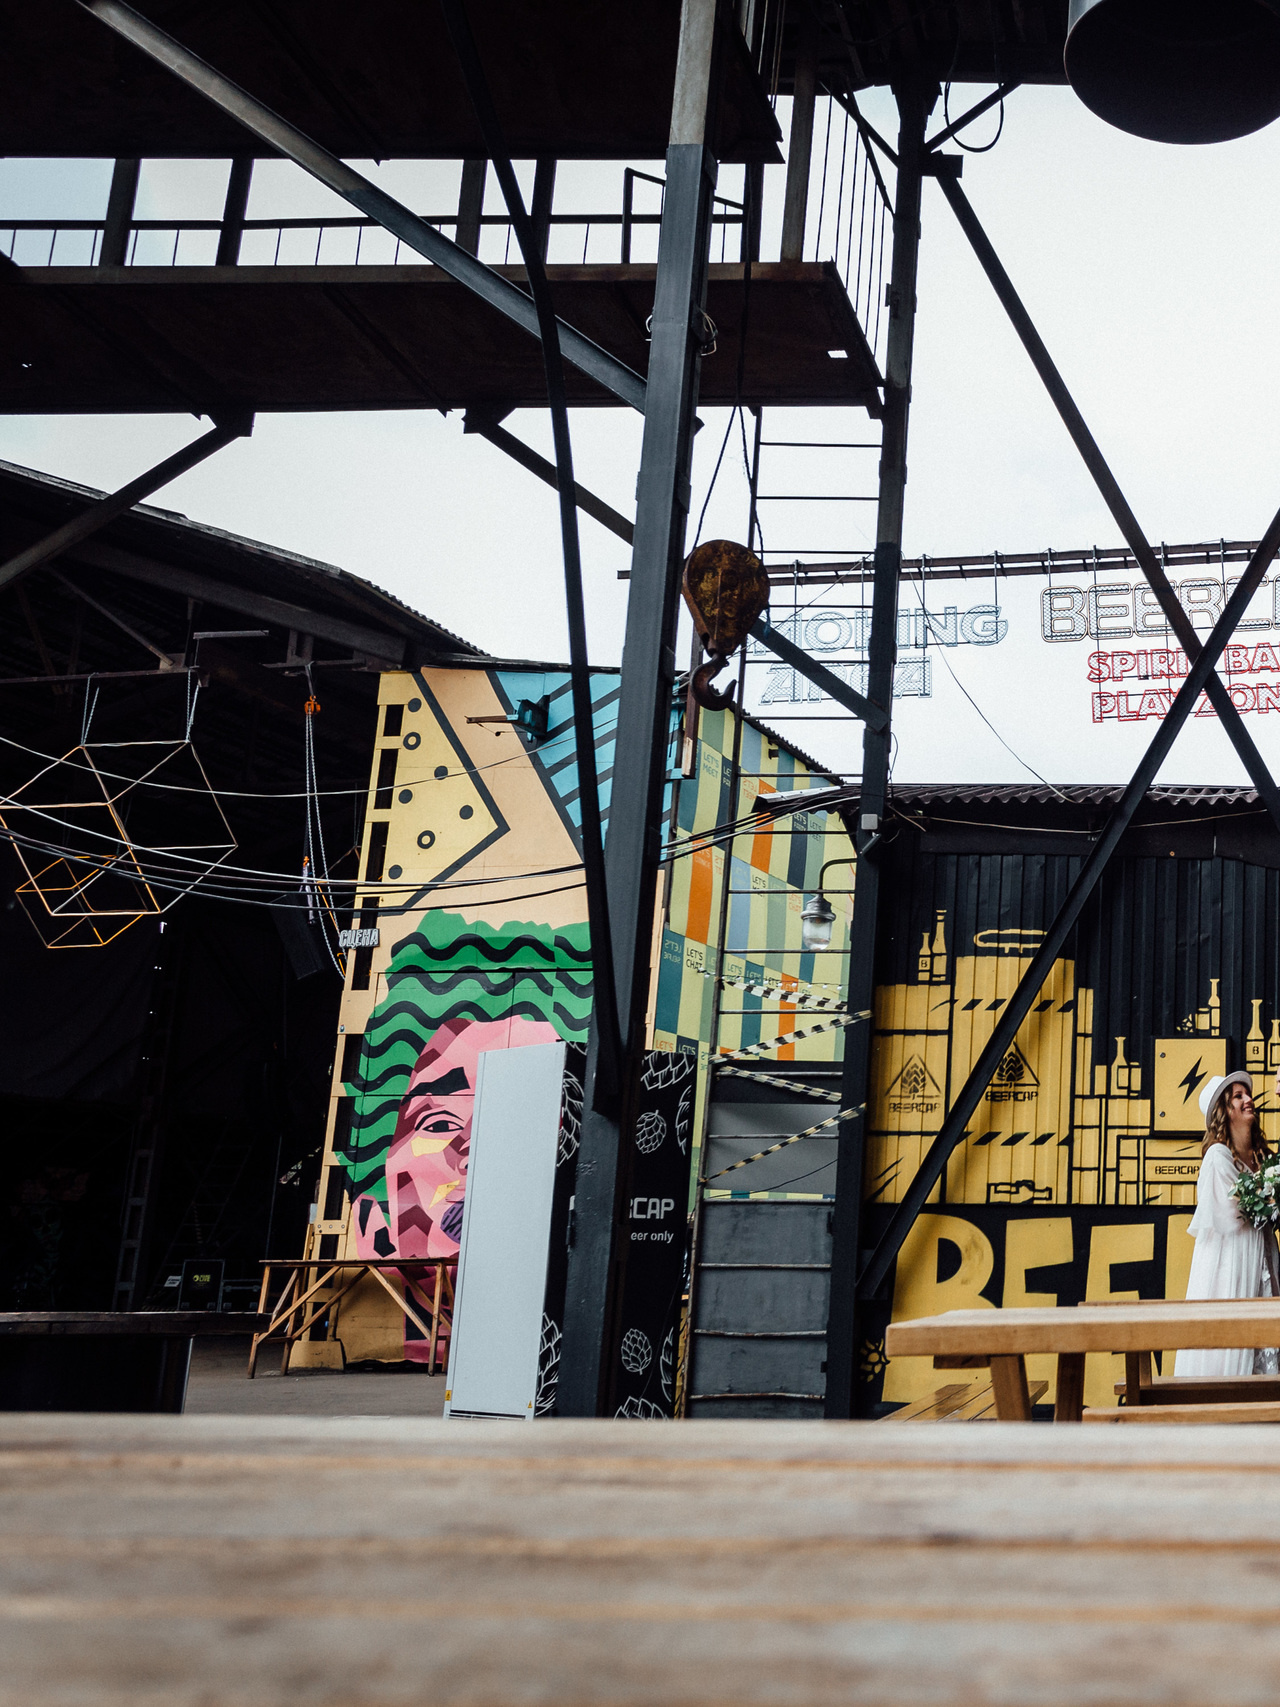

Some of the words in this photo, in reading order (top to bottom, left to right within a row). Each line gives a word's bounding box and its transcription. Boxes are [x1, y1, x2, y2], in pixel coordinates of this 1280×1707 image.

[1087, 649, 1196, 683] SPIRI
[339, 928, 379, 950] СЦЕНА
[686, 947, 703, 961] LET'S
[655, 1039, 674, 1052] LET'S
[678, 1043, 696, 1056] LET'S
[985, 1090, 1039, 1102] BEERCAP
[1155, 1165, 1200, 1175] BEERCAP
[629, 1197, 675, 1219] CAP
[630, 1231, 649, 1241] eer
[650, 1230, 674, 1244] only
